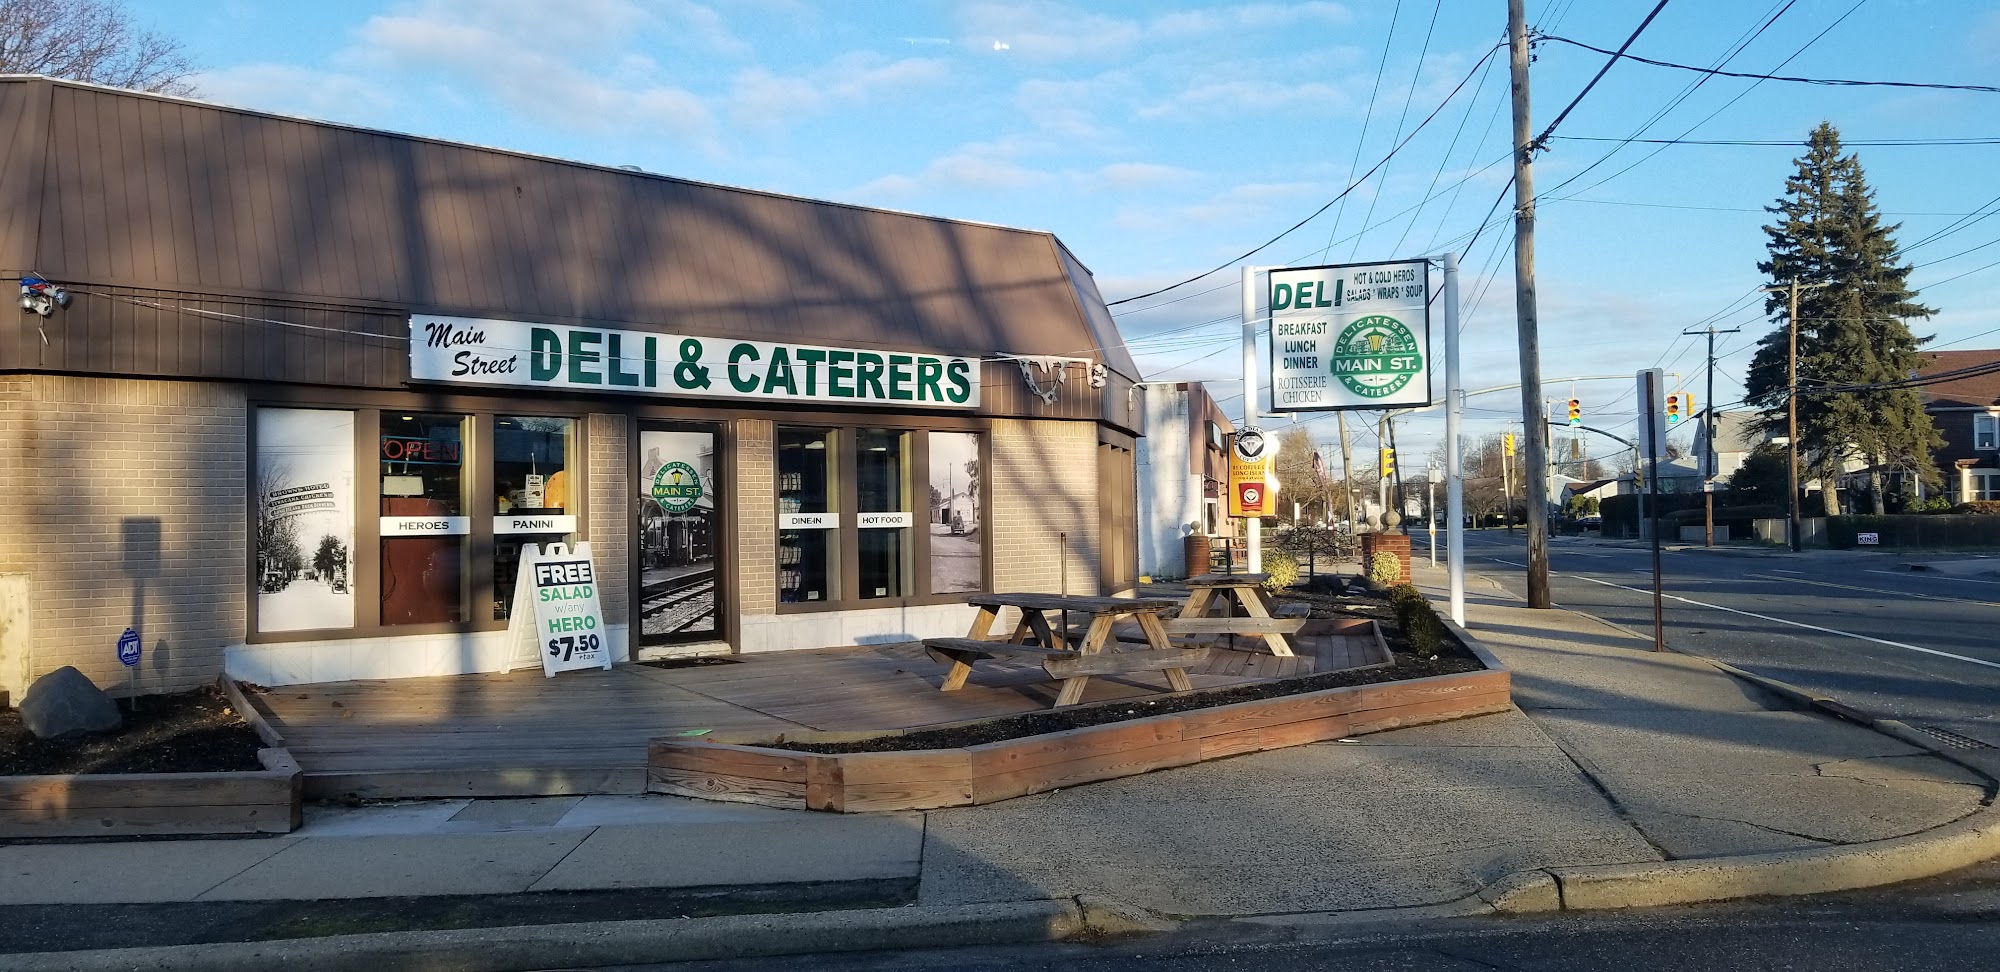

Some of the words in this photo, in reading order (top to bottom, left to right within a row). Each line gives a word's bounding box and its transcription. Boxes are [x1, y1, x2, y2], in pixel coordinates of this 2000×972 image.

[1353, 272, 1367, 285] HOT
[1368, 271, 1373, 284] &
[1374, 270, 1391, 283] COLD
[1393, 269, 1415, 282] HEROS
[1272, 279, 1344, 311] DELI
[1346, 288, 1371, 302] SALADS
[1377, 286, 1400, 299] WRAPS
[1405, 284, 1423, 298] SOUP
[425, 323, 486, 349] Main
[1278, 322, 1328, 336] BREAKFAST
[1336, 317, 1416, 353] DELICATESSEN
[1285, 340, 1316, 353] LUNCH
[452, 351, 517, 377] Street
[531, 327, 657, 388] DELI
[673, 338, 712, 391] &
[728, 343, 971, 403] CATERERS
[1283, 356, 1318, 370] DINNER
[1336, 358, 1382, 372] MAIN
[1390, 356, 1417, 370] ST.
[1278, 375, 1328, 390] ROTISSERIE
[1344, 377, 1352, 385] &
[1355, 375, 1408, 397] CATERERS
[1283, 390, 1322, 404] CHICKEN
[384, 440, 458, 460] OPEN
[655, 462, 699, 485] DELICATESSEN
[653, 487, 681, 496] MAIN
[685, 487, 701, 496] ST.
[398, 521, 450, 530] HEROES
[512, 520, 554, 529] PANINI
[880, 516, 903, 524] FOOD
[536, 563, 592, 585] FREE
[540, 586, 593, 602] SALAD
[555, 602, 585, 614] w/any
[548, 615, 596, 633] HERO
[122, 640, 138, 655] ADT
[548, 633, 600, 662] $7.50
